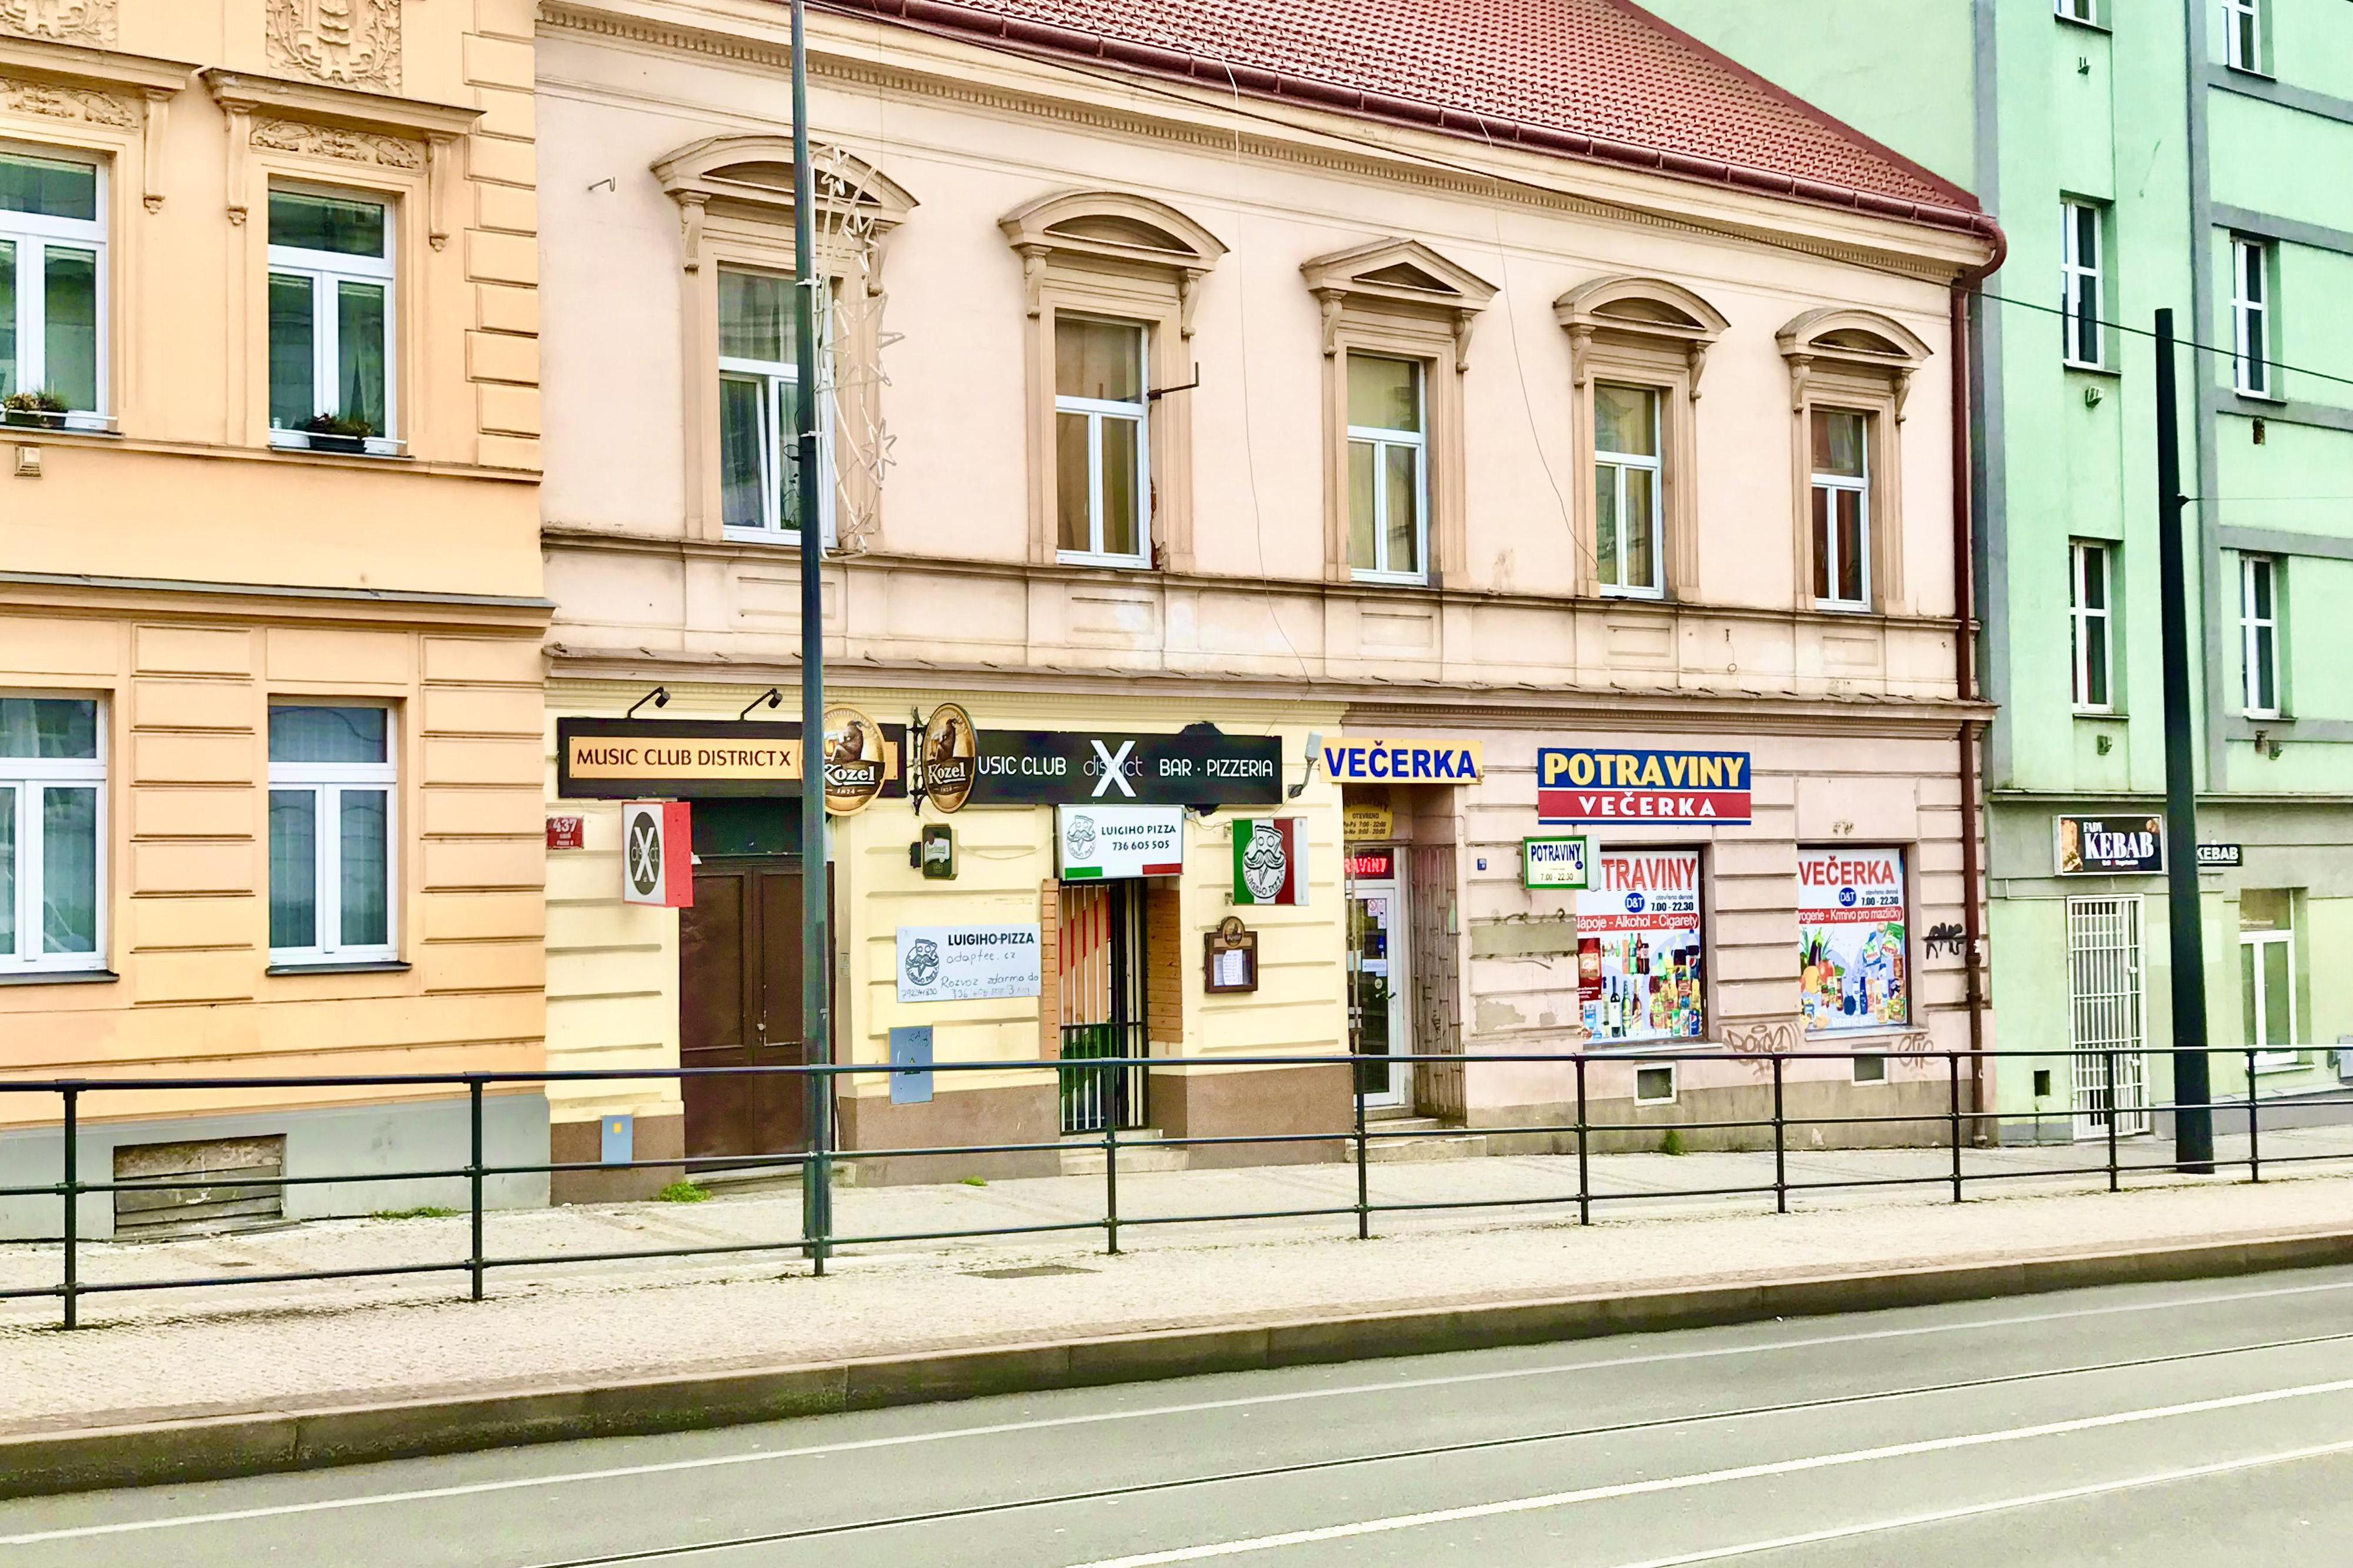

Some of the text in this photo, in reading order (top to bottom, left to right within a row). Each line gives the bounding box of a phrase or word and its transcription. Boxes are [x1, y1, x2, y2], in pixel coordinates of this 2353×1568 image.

[577, 748, 638, 765] MUSIC
[645, 748, 692, 766] CLUB
[1324, 740, 1477, 778] VEČERKA
[824, 763, 875, 786] Kozel
[928, 762, 966, 785] Kozel
[978, 756, 1017, 775] USIC
[1021, 756, 1066, 775] CLUB
[1159, 758, 1192, 776] BAR
[1207, 759, 1273, 777] PIZZERIA
[1544, 753, 1744, 787] POTRAVINY
[1578, 792, 1717, 816] VEČERKA
[553, 818, 577, 832] 437
[1101, 825, 1176, 836] LUIGIHO PIZZA
[1113, 840, 1169, 850] 736 605 505
[1531, 843, 1581, 862] POTRAVINY
[2084, 832, 2155, 859] KEBAB
[2198, 847, 2239, 860] KEBAB
[1601, 858, 1697, 891] TRAVINY
[1798, 855, 1895, 886] VEČERKA
[1626, 898, 1644, 908] D&T
[1840, 892, 1855, 902] D&T
[1880, 896, 1899, 906] 22.30
[1651, 902, 1667, 912] 7.00
[1672, 902, 1694, 911] 22.30
[1615, 915, 1651, 928] Alkohol
[1658, 915, 1697, 929] Cigarety
[1799, 910, 1825, 923] rogerie
[1830, 909, 1857, 921] Krmivo
[1857, 911, 1869, 922] pro
[941, 975, 978, 989] Rozvoz
[1028, 972, 1039, 982] do
